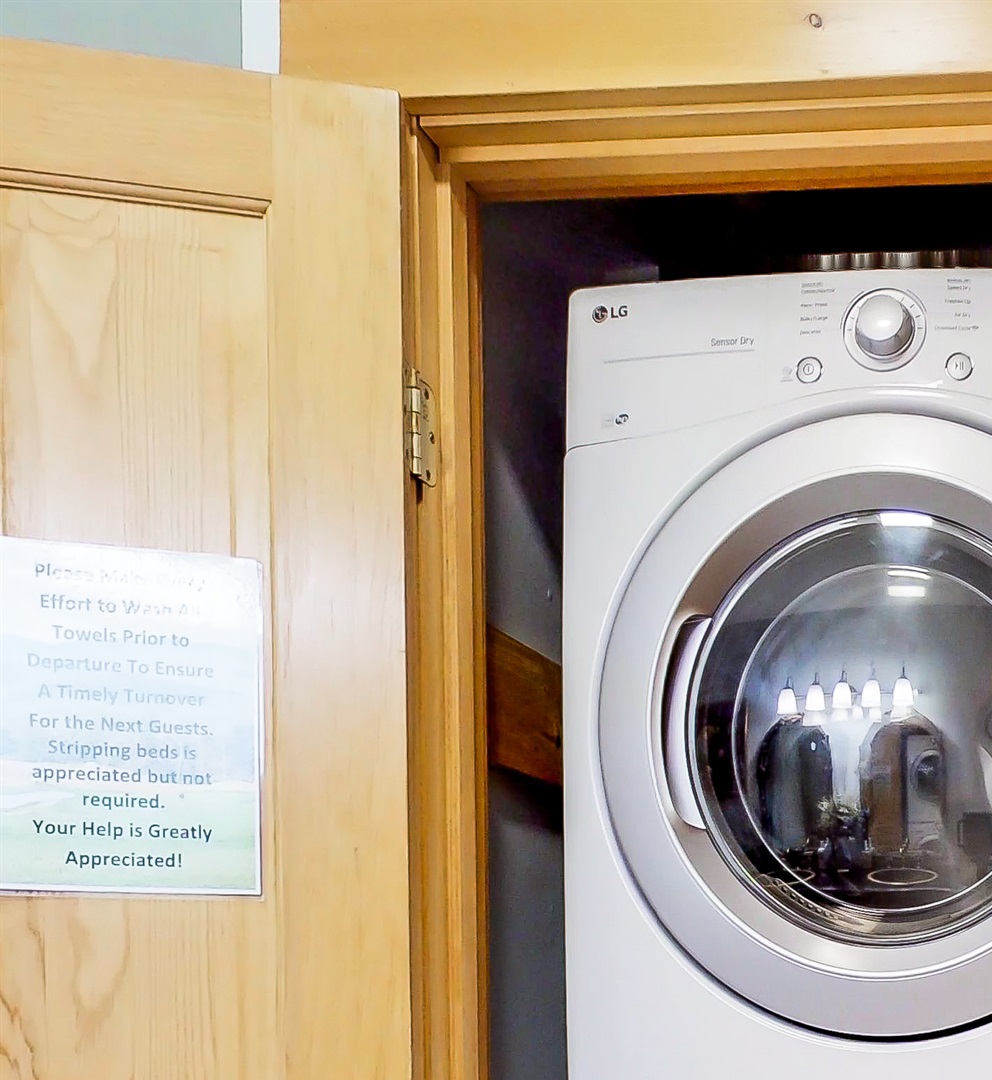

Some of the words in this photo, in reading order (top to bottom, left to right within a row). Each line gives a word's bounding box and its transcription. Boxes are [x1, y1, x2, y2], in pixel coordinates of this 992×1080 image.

[611, 305, 628, 319] LG
[710, 338, 738, 347] Sensor
[740, 336, 755, 346] Dry
[40, 594, 92, 612] Effort
[98, 599, 117, 613] to
[52, 624, 117, 643] Towels
[123, 629, 166, 646] Prior
[172, 633, 190, 648] to
[27, 652, 121, 673] Departure
[127, 659, 149, 675] To
[156, 661, 214, 679] Ensure
[38, 683, 51, 699] A
[57, 684, 118, 706] Timely
[124, 688, 206, 707] Turnover
[30, 713, 59, 730] For
[65, 714, 95, 731] the
[101, 717, 143, 733] Next
[149, 720, 214, 737] Guests.
[48, 739, 131, 761] Stripping
[137, 743, 178, 760] beds
[184, 747, 197, 761] is
[32, 765, 141, 784] appreciated
[149, 769, 177, 785] but
[184, 771, 213, 786] not
[83, 792, 165, 811] required.
[33, 819, 76, 836] Your
[83, 821, 124, 839] Help
[130, 823, 143, 838] is
[149, 823, 213, 843] Greatly
[65, 850, 182, 869] Appreciated!
